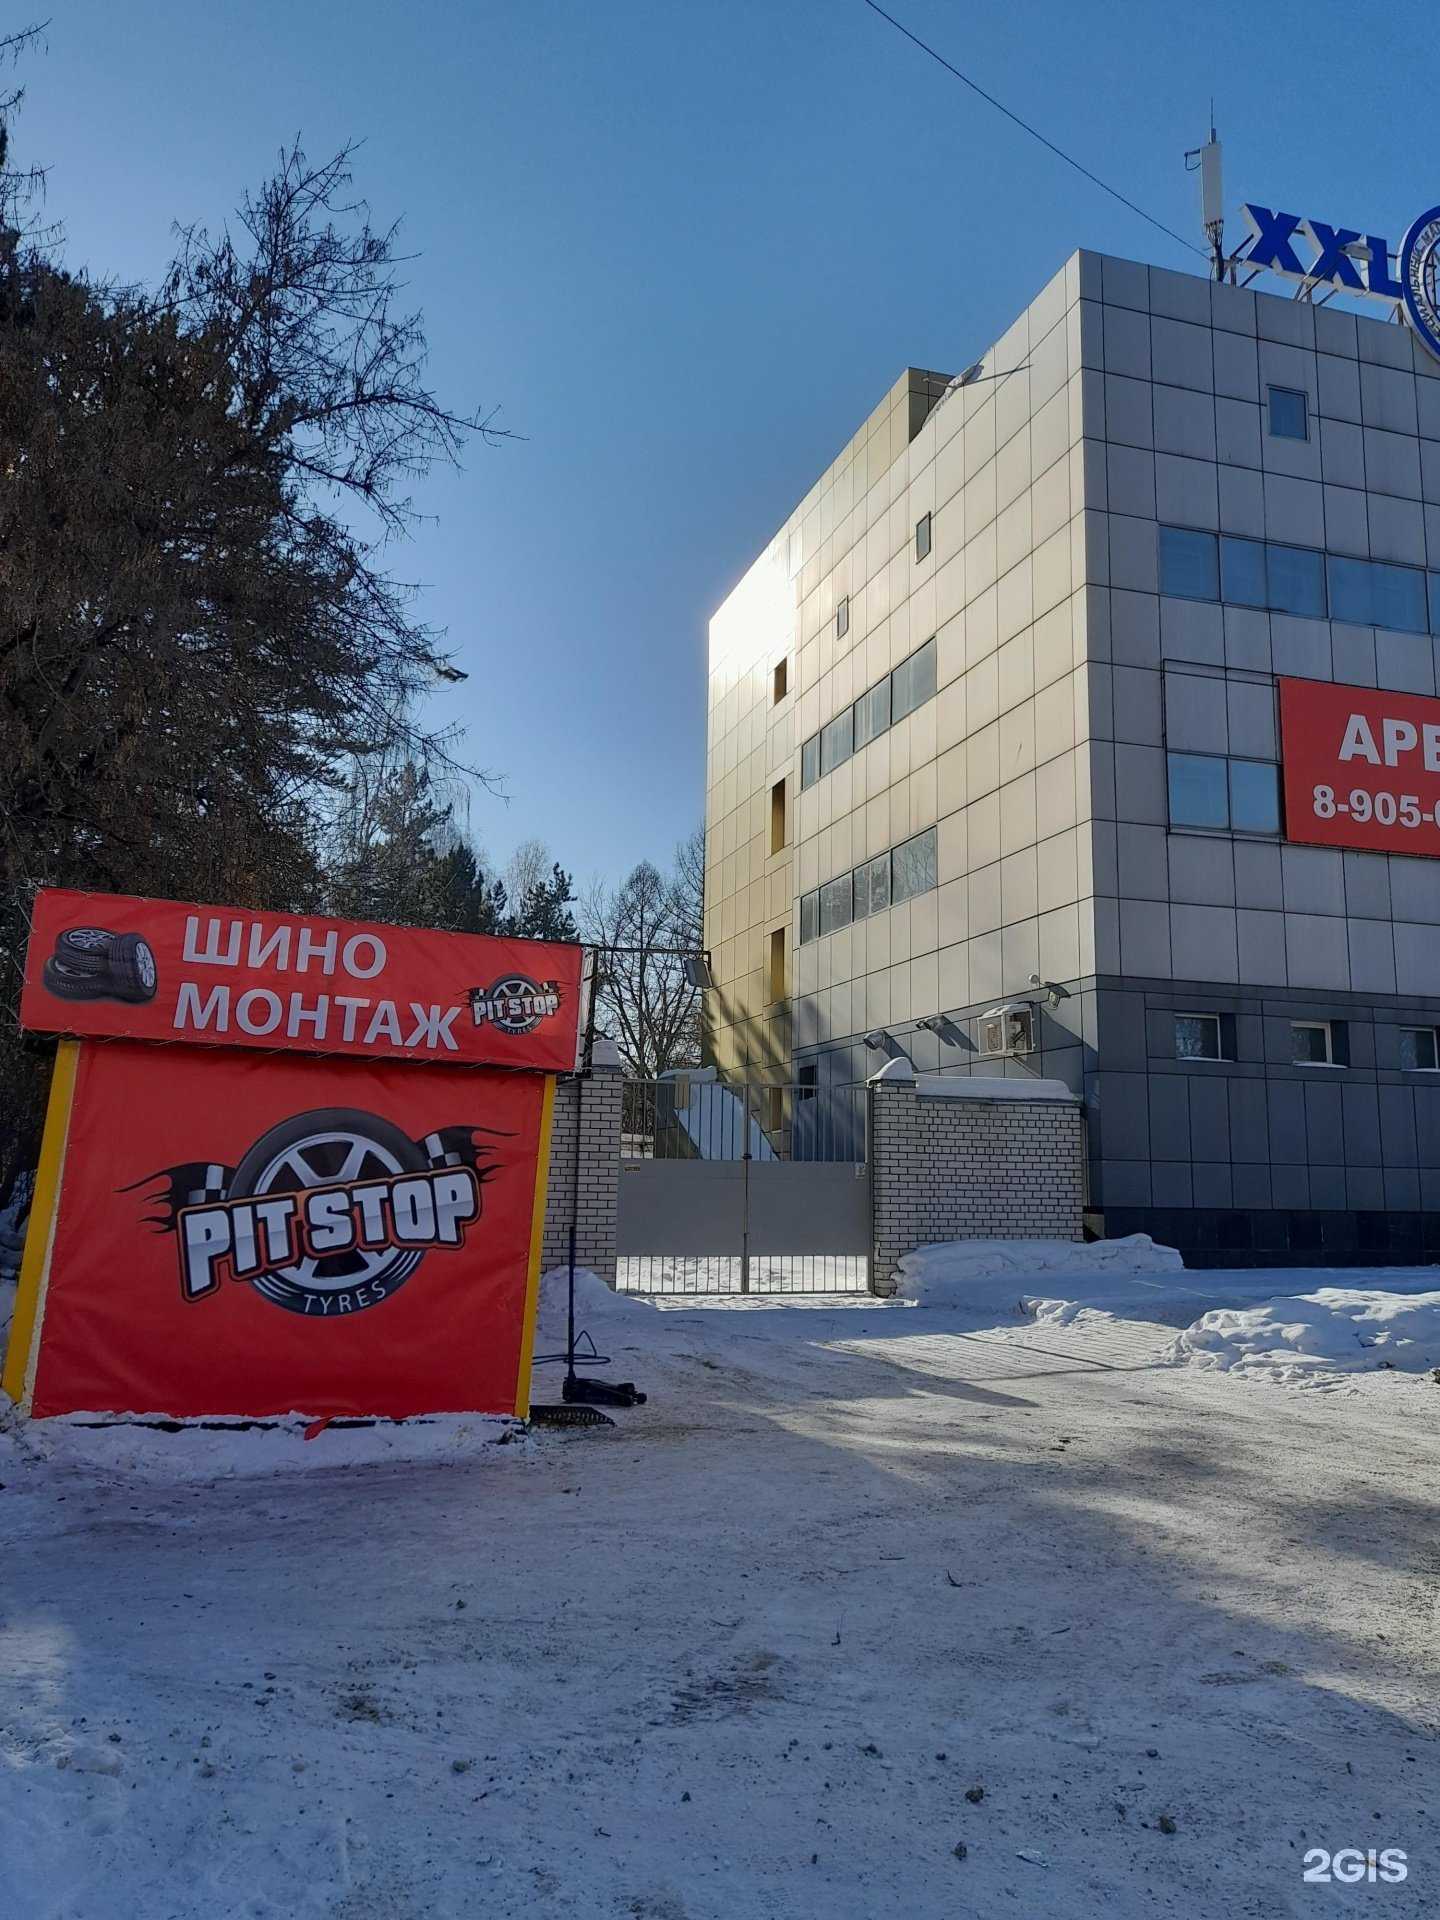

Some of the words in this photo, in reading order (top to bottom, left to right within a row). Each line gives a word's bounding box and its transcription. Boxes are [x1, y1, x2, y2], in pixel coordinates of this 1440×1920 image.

[1243, 203, 1403, 300] XXL
[1338, 713, 1440, 772] АРЕ
[1313, 784, 1440, 830] 8-905-
[183, 916, 387, 979] ШИНО
[173, 982, 462, 1050] МОНТАЖ
[303, 1282, 387, 1314] TYRES
